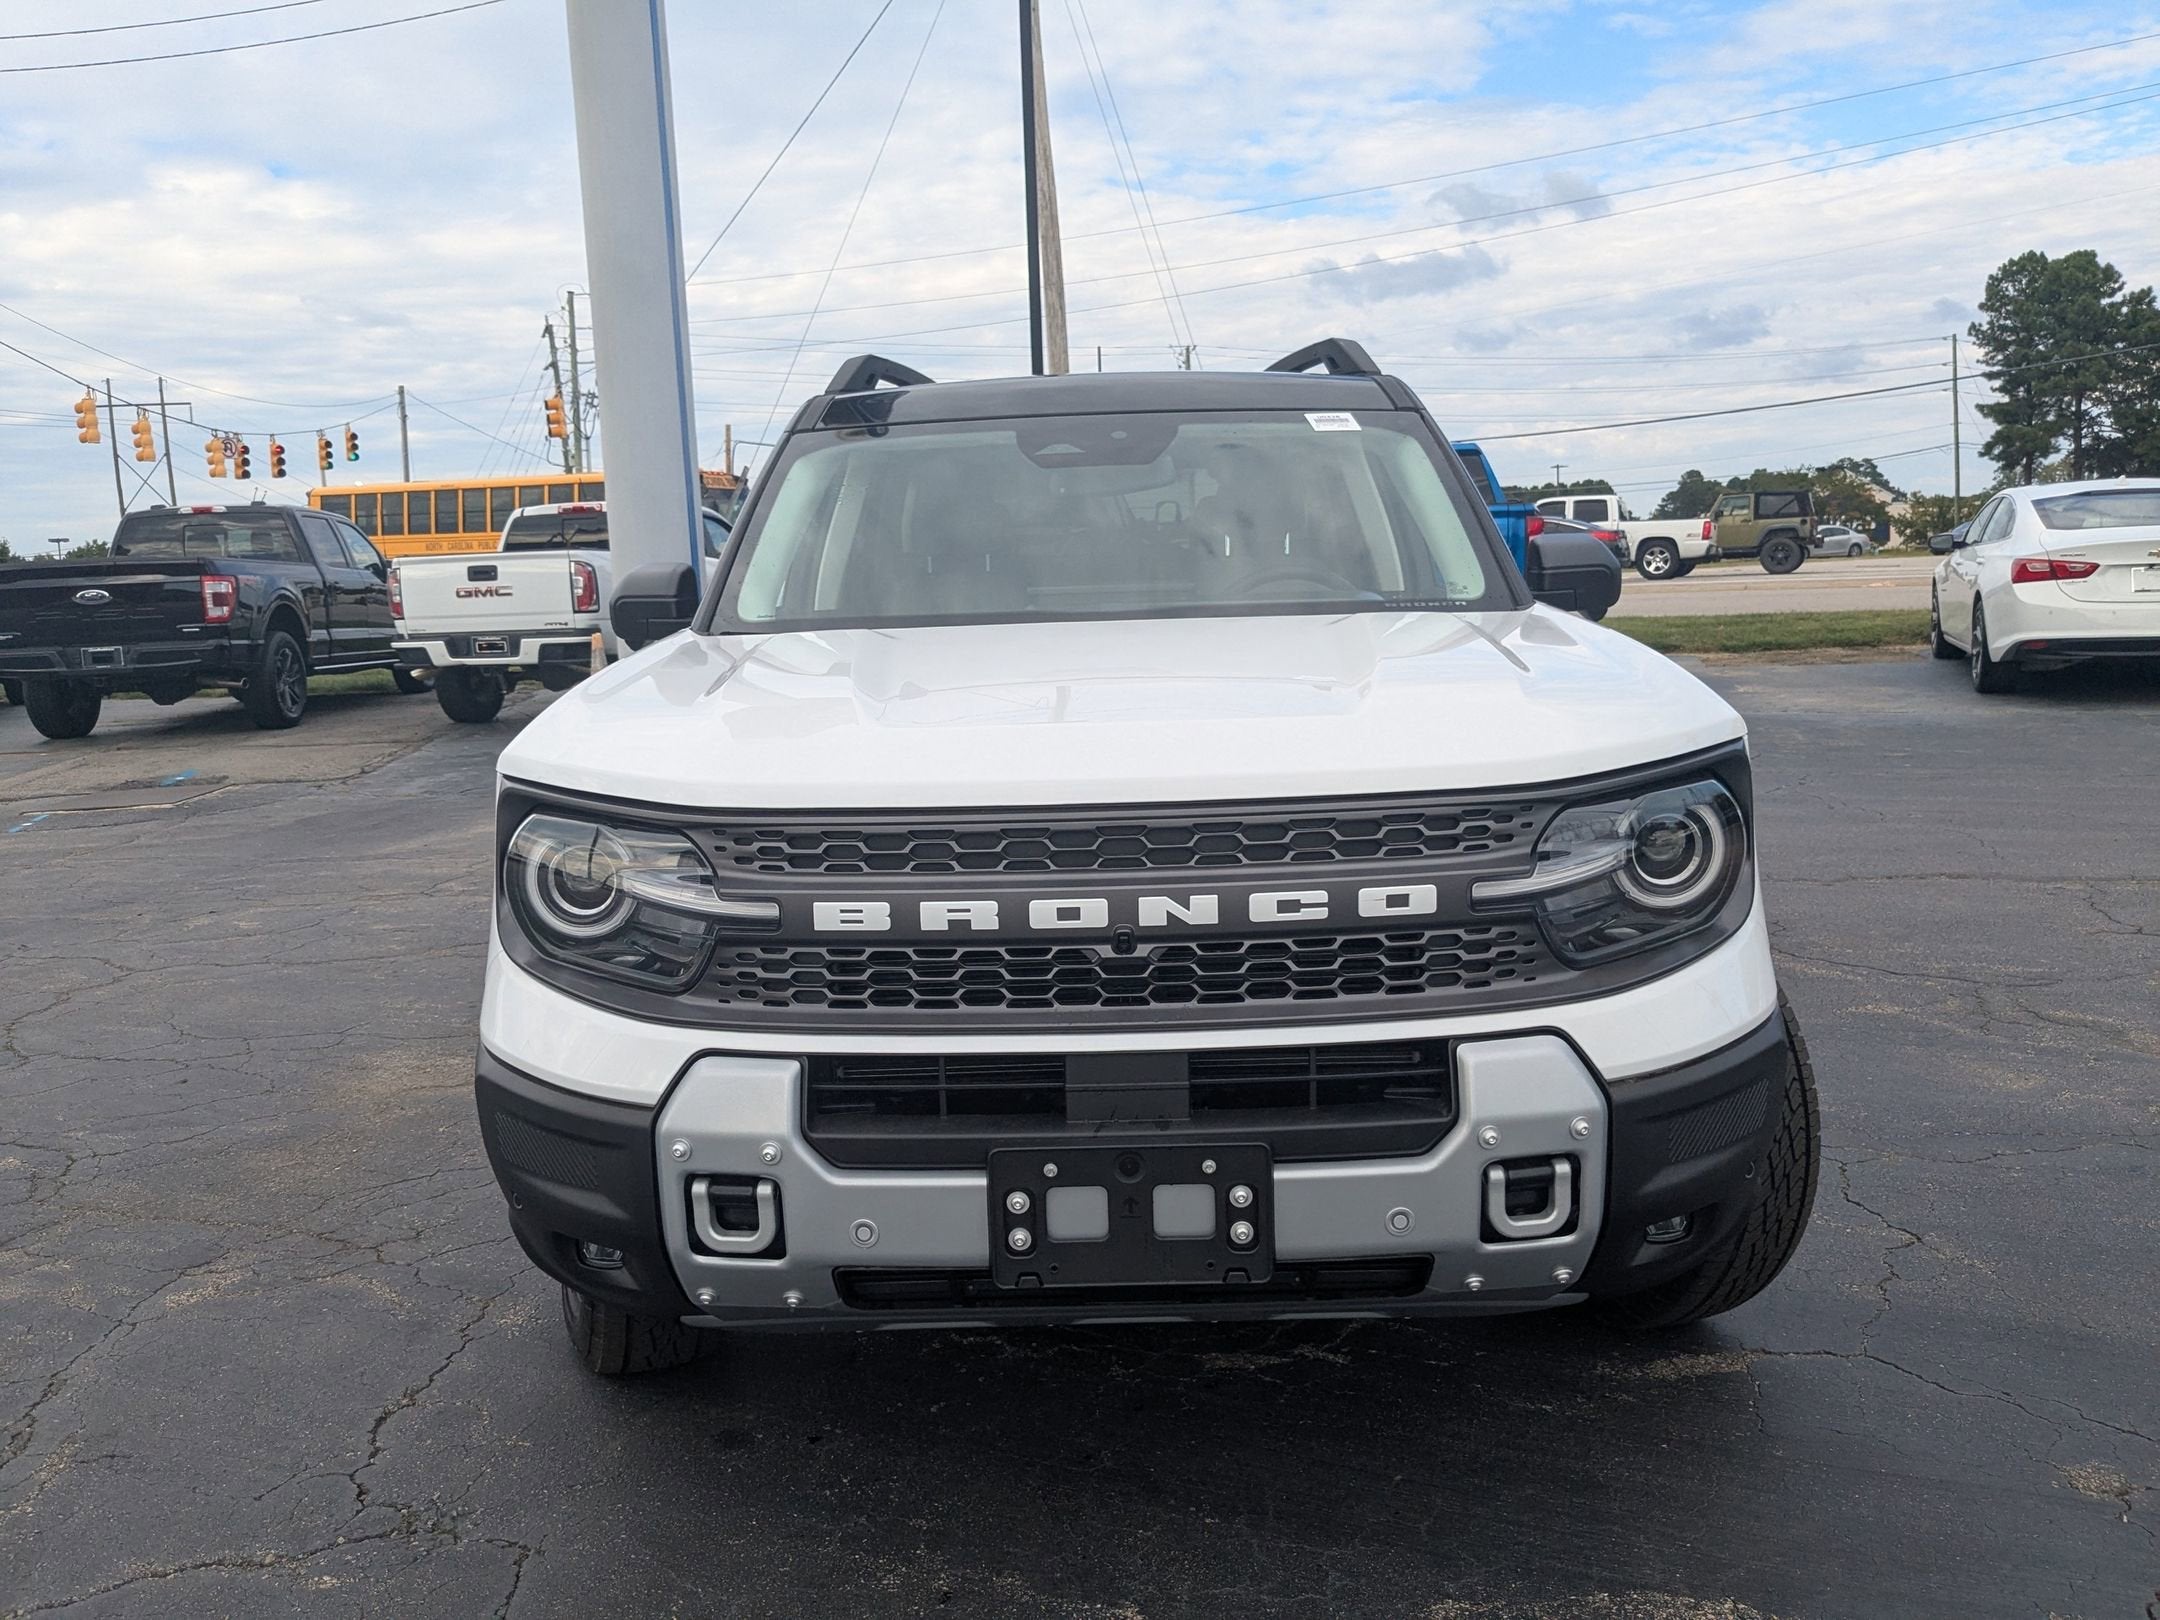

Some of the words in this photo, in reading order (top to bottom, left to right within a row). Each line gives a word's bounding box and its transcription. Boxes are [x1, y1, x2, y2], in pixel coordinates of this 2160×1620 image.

[425, 542, 443, 552] NORTH
[447, 541, 474, 550] CAROLINA
[455, 586, 513, 598] GMC
[812, 884, 1438, 932] BRONCO
